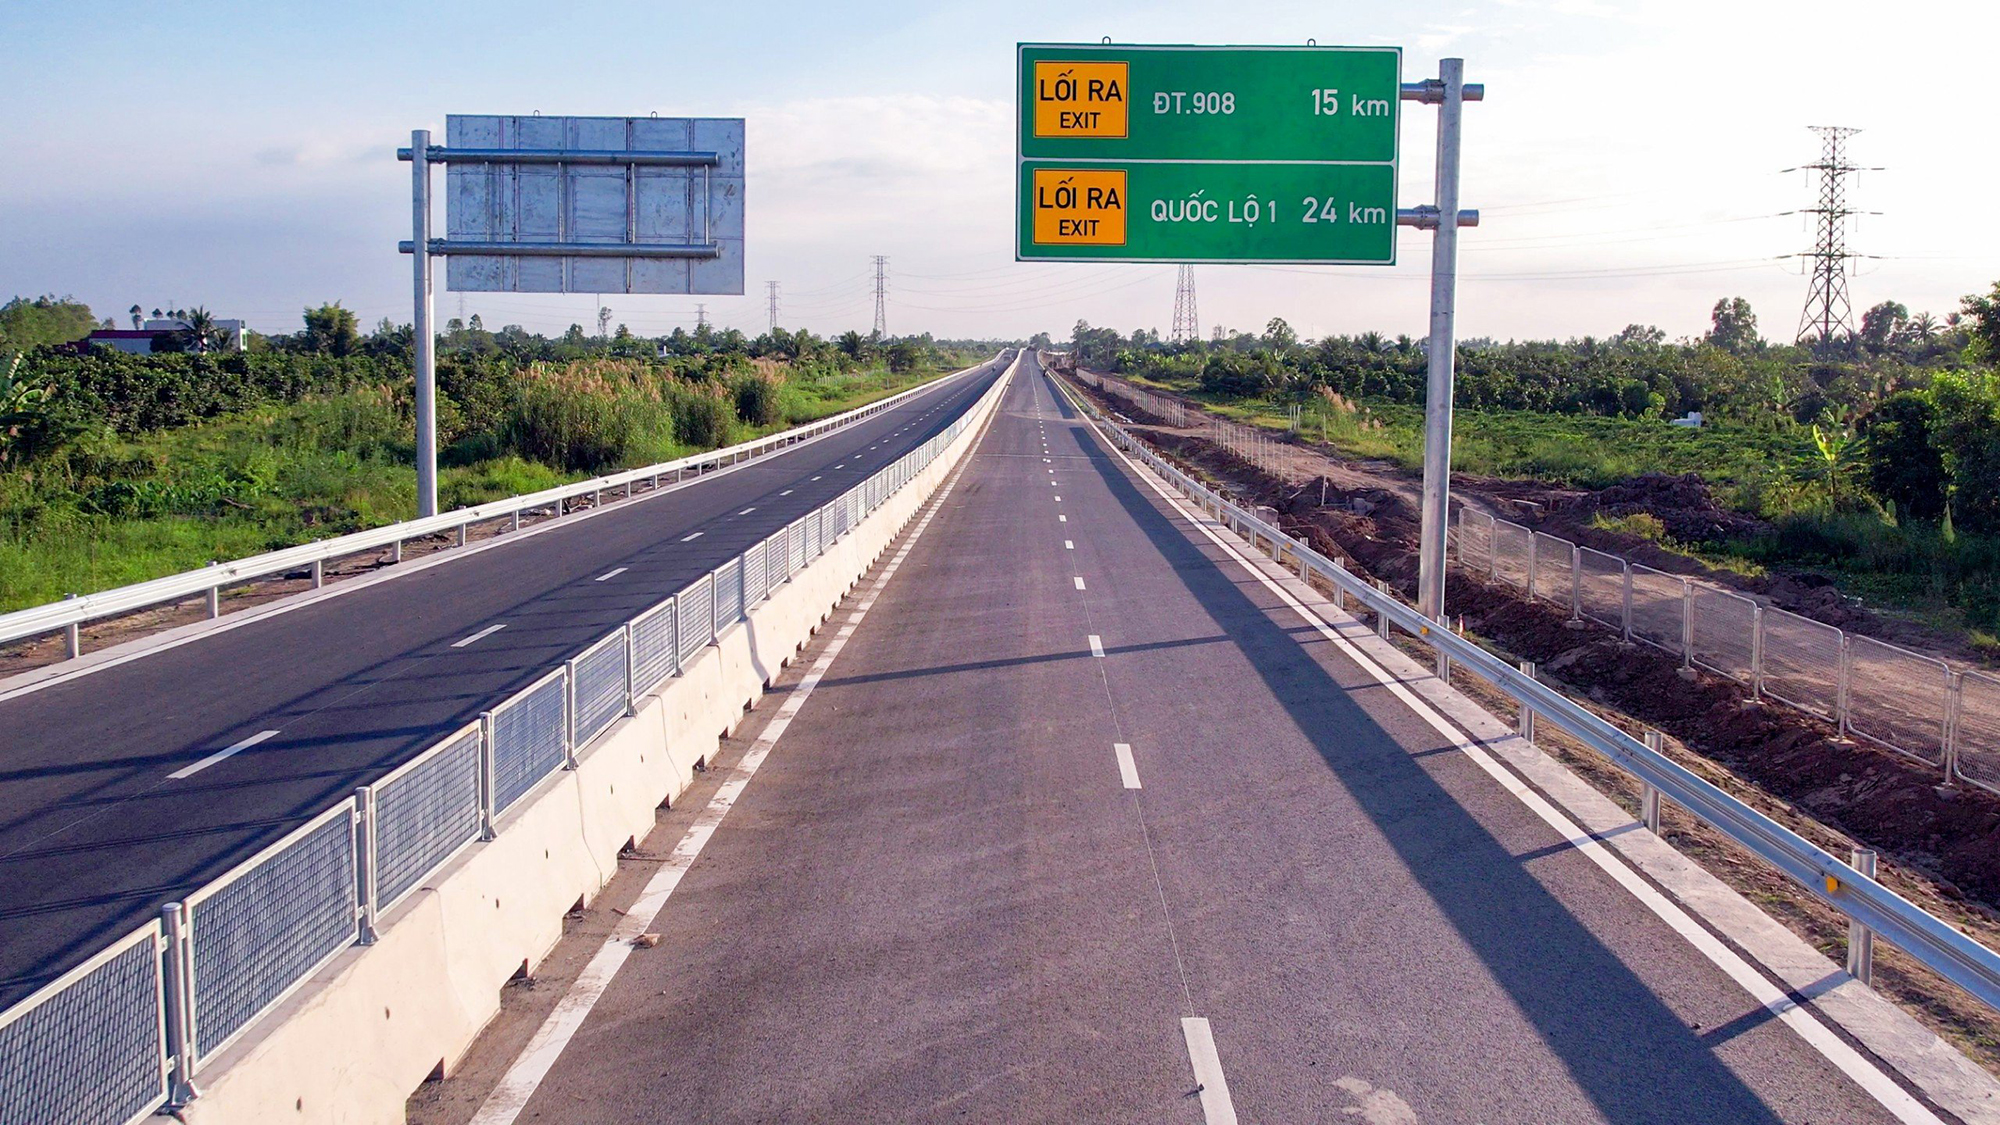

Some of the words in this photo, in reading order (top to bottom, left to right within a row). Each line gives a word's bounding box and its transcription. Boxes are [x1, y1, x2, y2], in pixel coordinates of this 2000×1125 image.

[1039, 68, 1078, 102] LỐI
[1088, 79, 1123, 102] RA
[1152, 91, 1236, 115] ĐT.908
[1311, 88, 1338, 116] 15
[1352, 94, 1389, 116] km
[1059, 111, 1102, 129] EXIT
[1038, 176, 1077, 209] LỐI
[1087, 187, 1122, 210] RA
[1150, 189, 1218, 223] QUỐC
[1228, 194, 1260, 228] LỘ
[1267, 200, 1276, 223] 1
[1302, 196, 1338, 223] 24
[1349, 201, 1386, 224] km
[1058, 219, 1100, 237] EXIT
